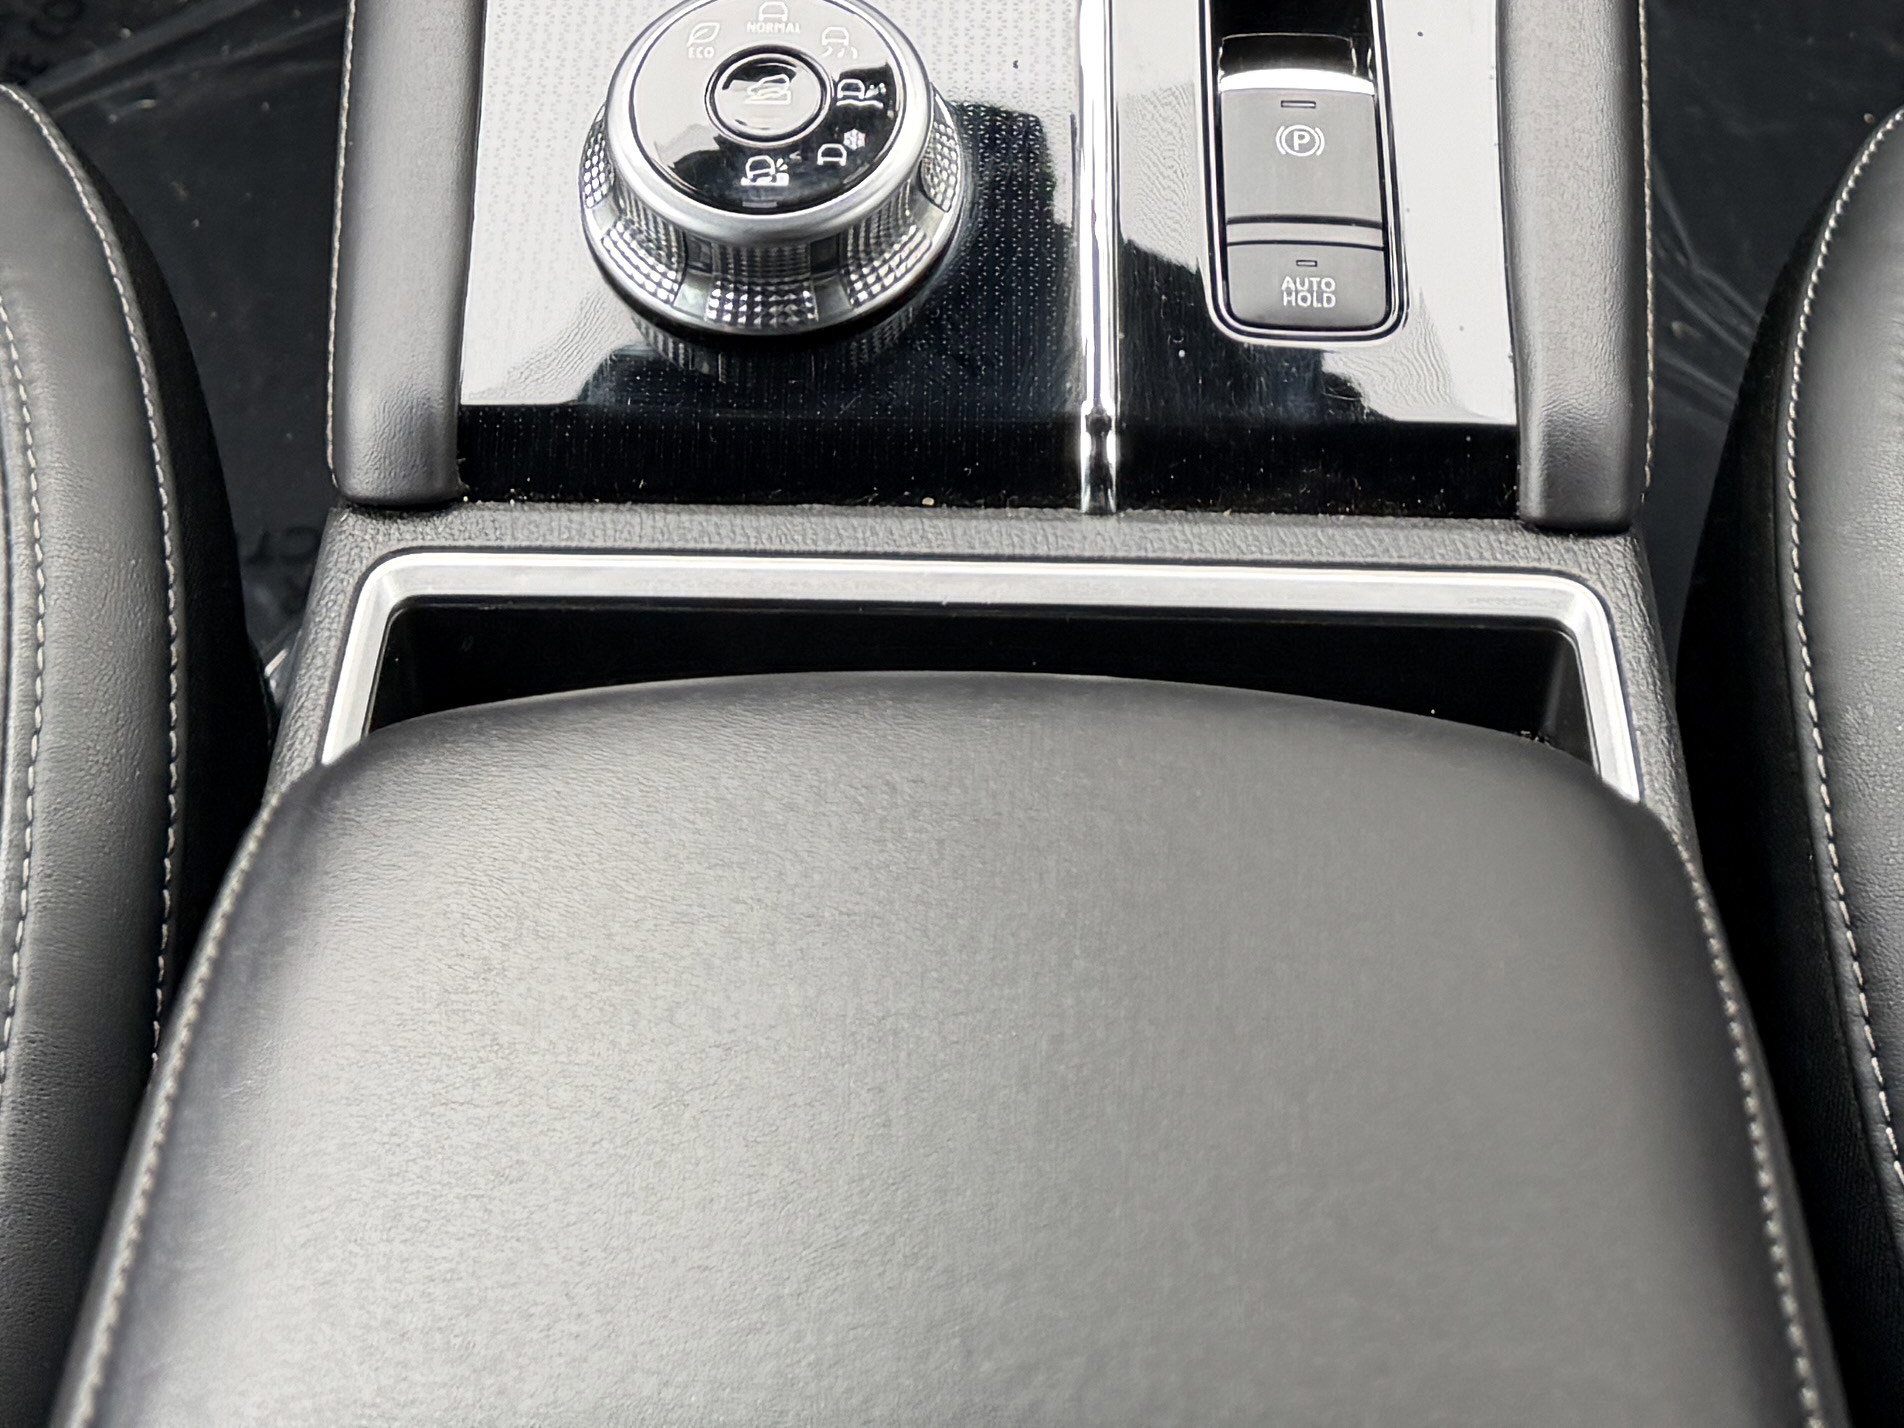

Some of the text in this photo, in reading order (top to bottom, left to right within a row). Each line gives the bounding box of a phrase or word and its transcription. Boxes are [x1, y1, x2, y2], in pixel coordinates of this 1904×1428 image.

[747, 22, 801, 33] NORMAL
[688, 47, 714, 58] ECO
[1281, 276, 1336, 290] AUTO
[1283, 291, 1336, 308] HOLD
